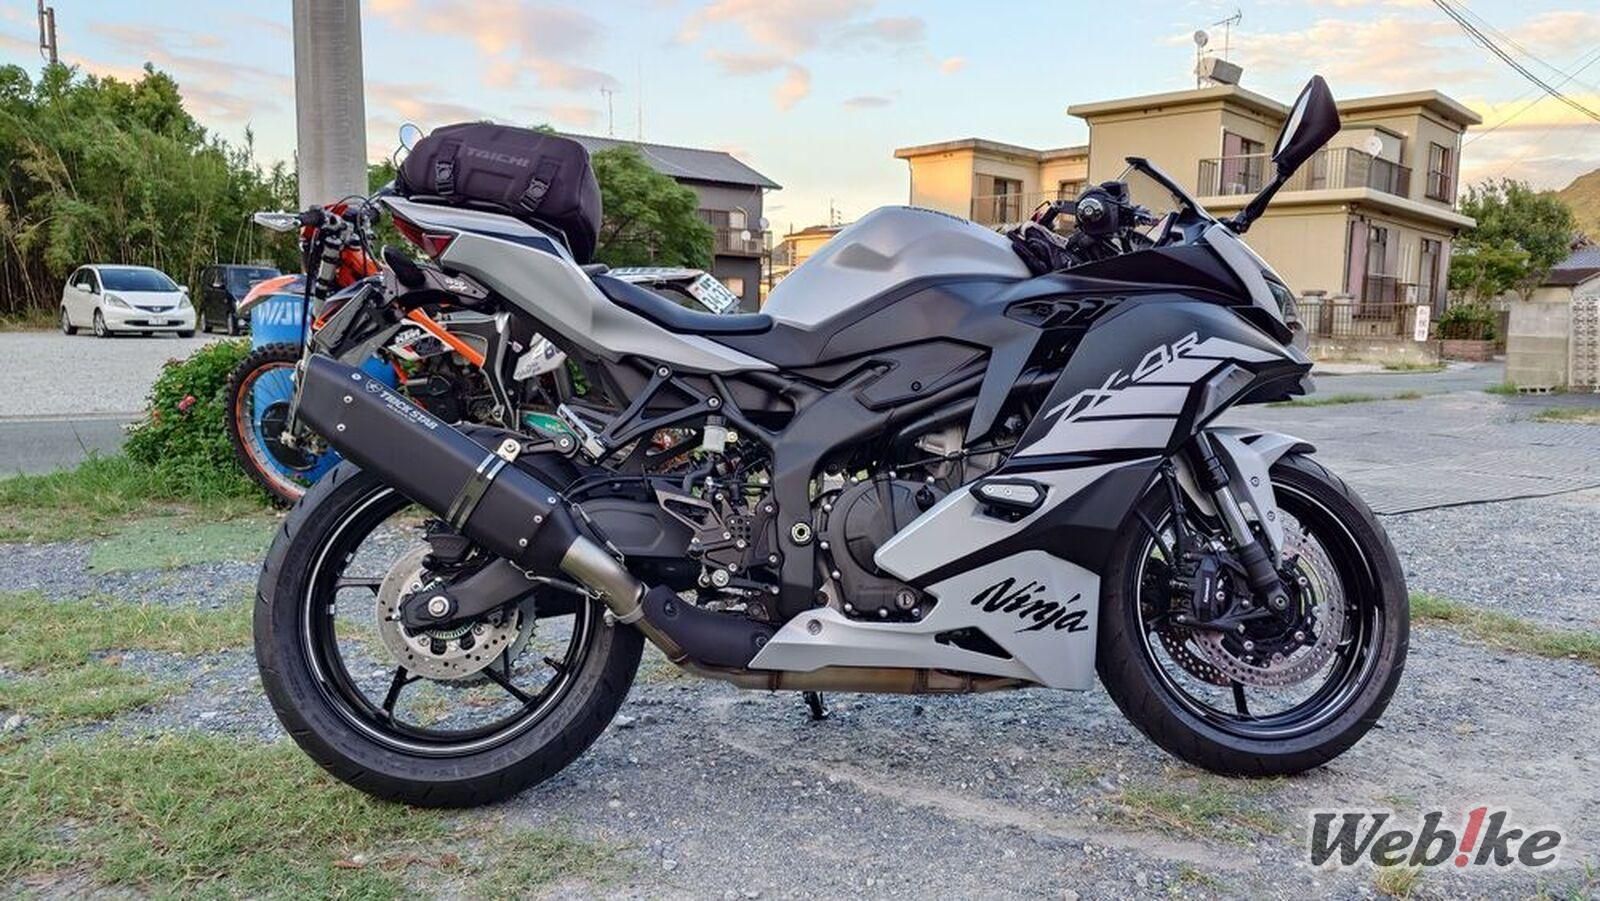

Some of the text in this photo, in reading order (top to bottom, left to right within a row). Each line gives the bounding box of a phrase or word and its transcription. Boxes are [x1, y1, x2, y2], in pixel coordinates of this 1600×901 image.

[466, 146, 530, 168] TAICHI
[380, 389, 413, 413] TRICK
[409, 409, 439, 430] STAR
[970, 577, 1089, 633] Ninja
